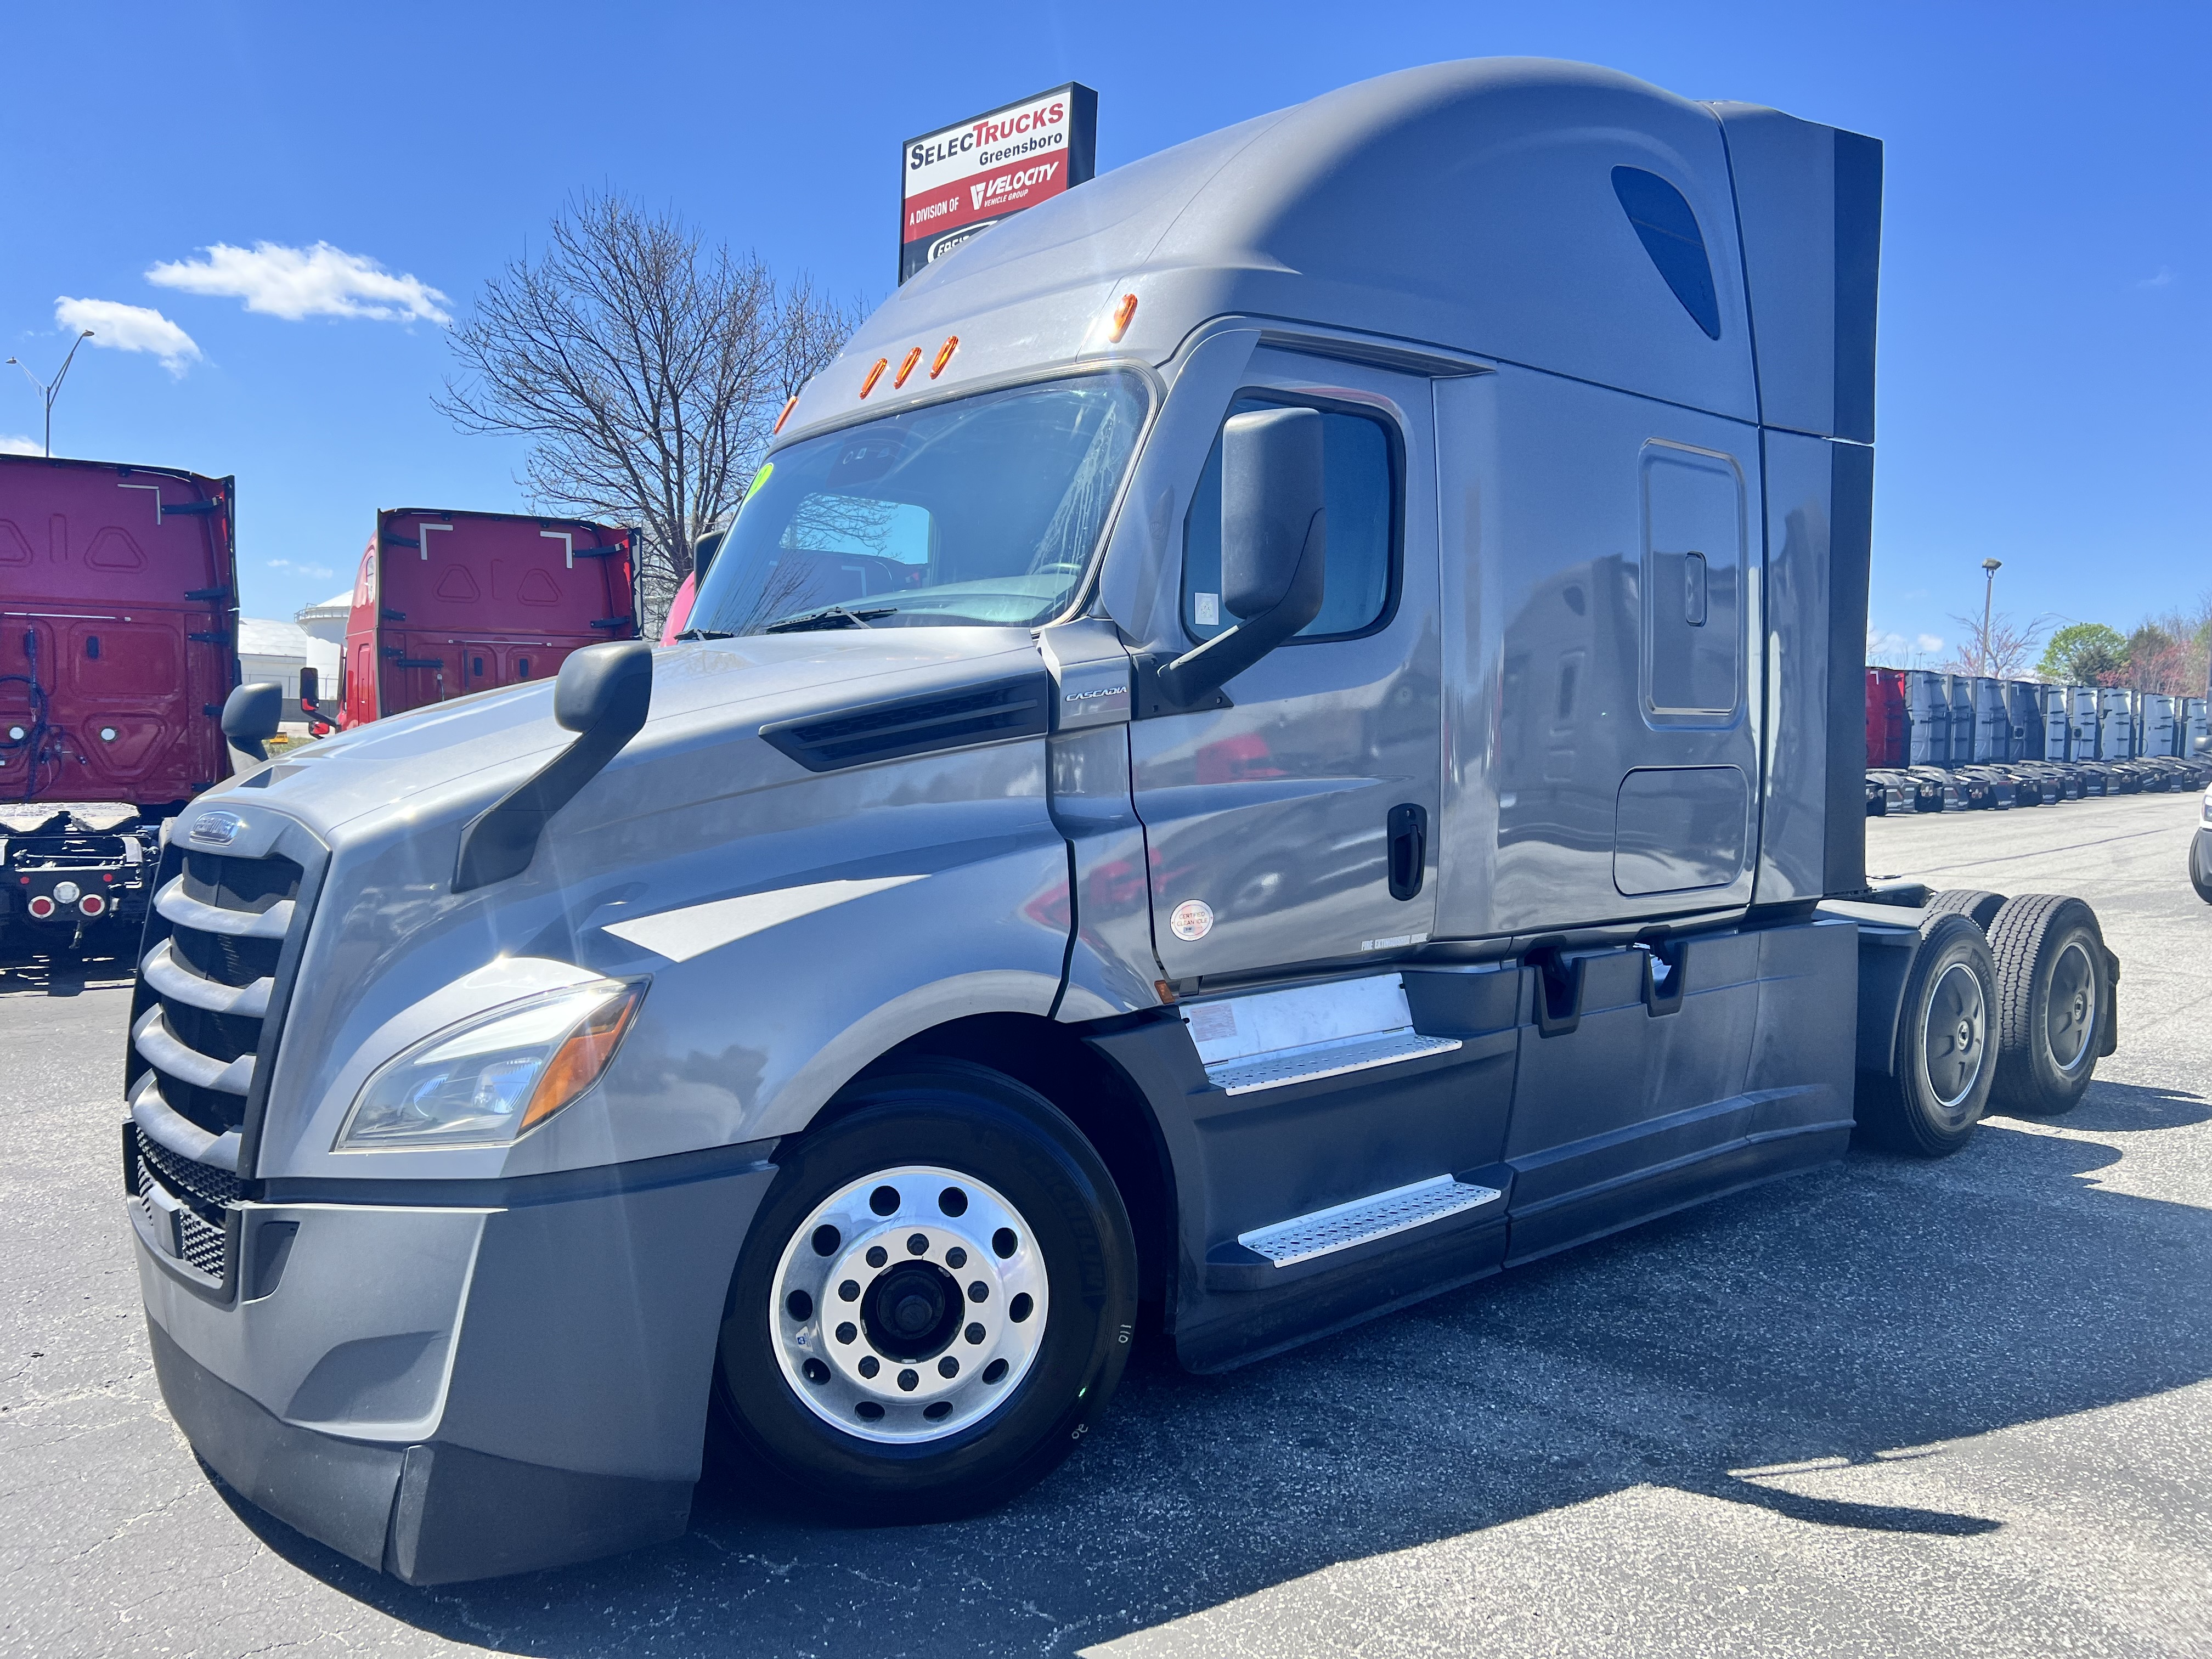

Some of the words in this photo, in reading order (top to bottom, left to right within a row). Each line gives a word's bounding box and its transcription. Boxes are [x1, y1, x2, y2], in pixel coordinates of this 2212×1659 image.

[979, 132, 1063, 166] Greensboro
[986, 161, 1059, 198] VELOCITY
[909, 212, 915, 226] A
[916, 200, 947, 224] DIVISION
[949, 196, 960, 212] OF
[984, 194, 1007, 207] VEHICLE
[1008, 189, 1029, 200] GROUP
[1065, 686, 1127, 702] CASCADIA
